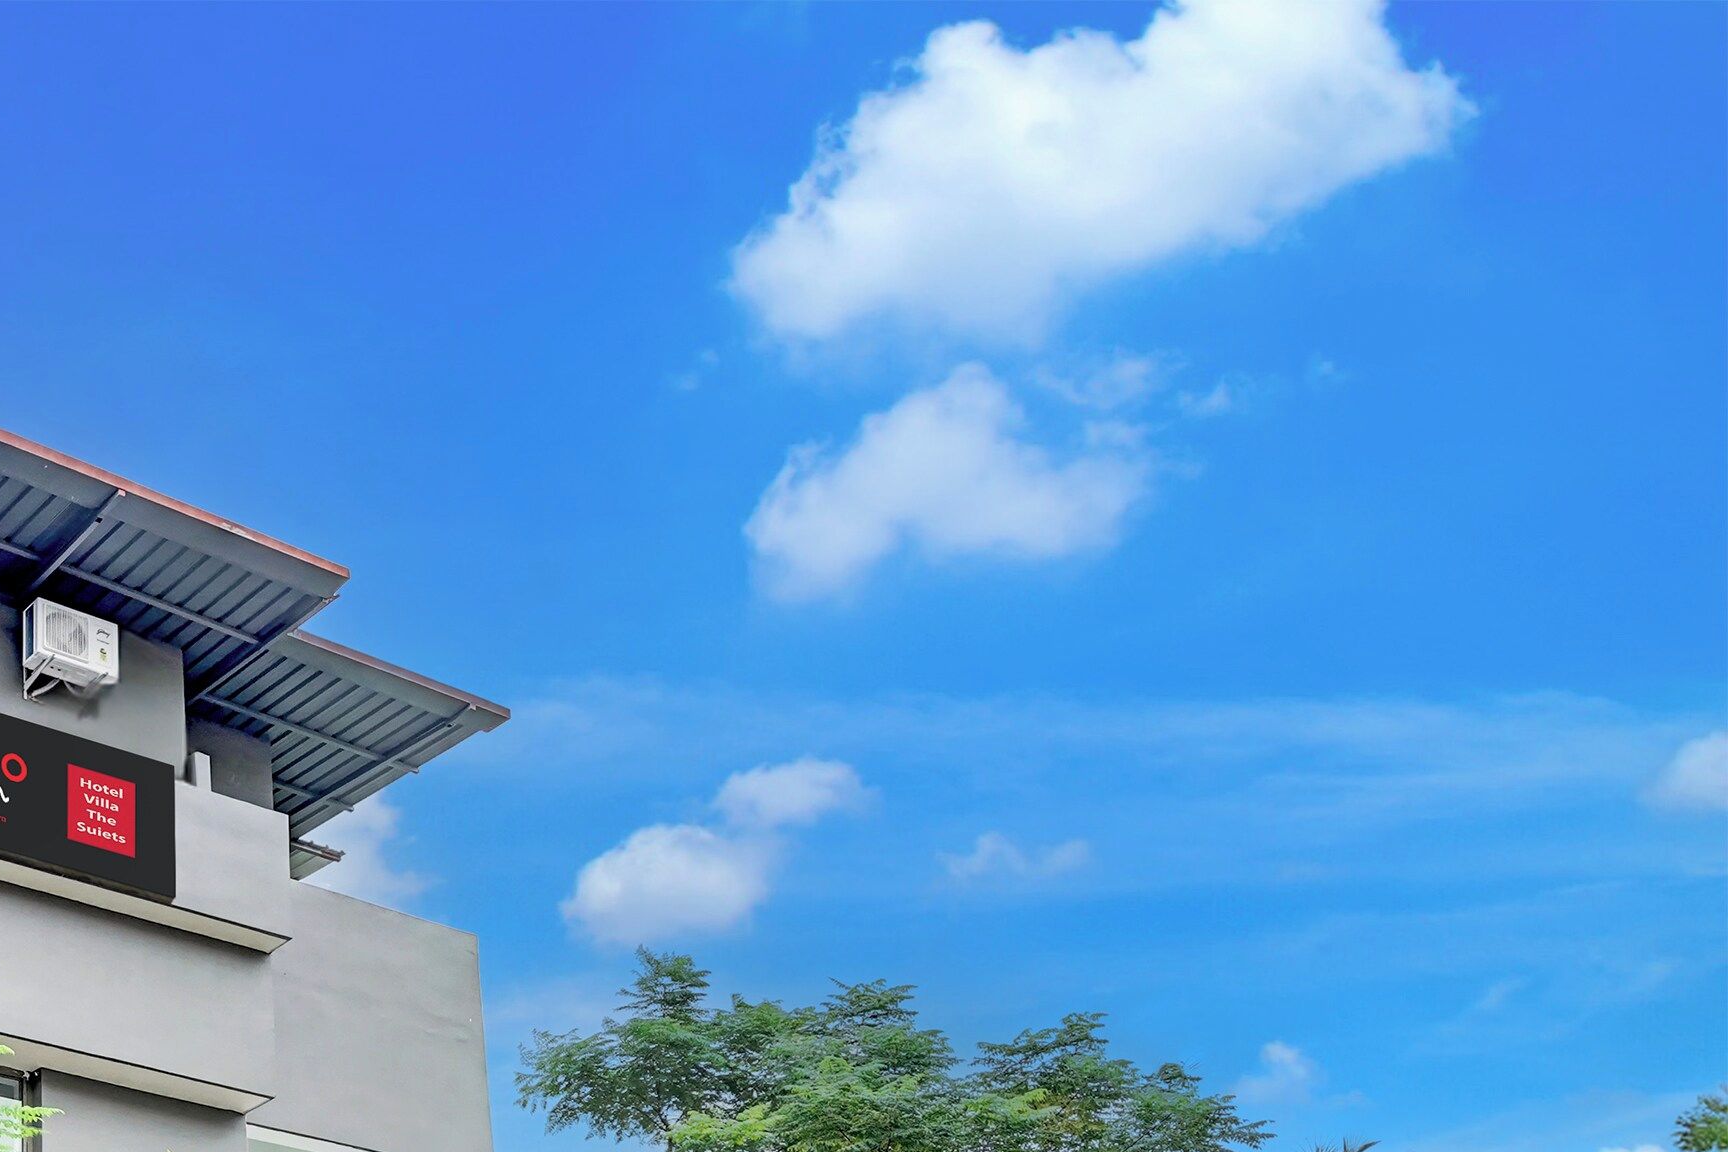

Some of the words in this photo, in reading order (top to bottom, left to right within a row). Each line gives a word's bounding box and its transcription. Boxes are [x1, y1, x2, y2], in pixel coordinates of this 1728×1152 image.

[80, 777, 123, 799] Hotel
[84, 793, 119, 812] Villa
[86, 809, 117, 826] The
[76, 821, 126, 844] Suiets
